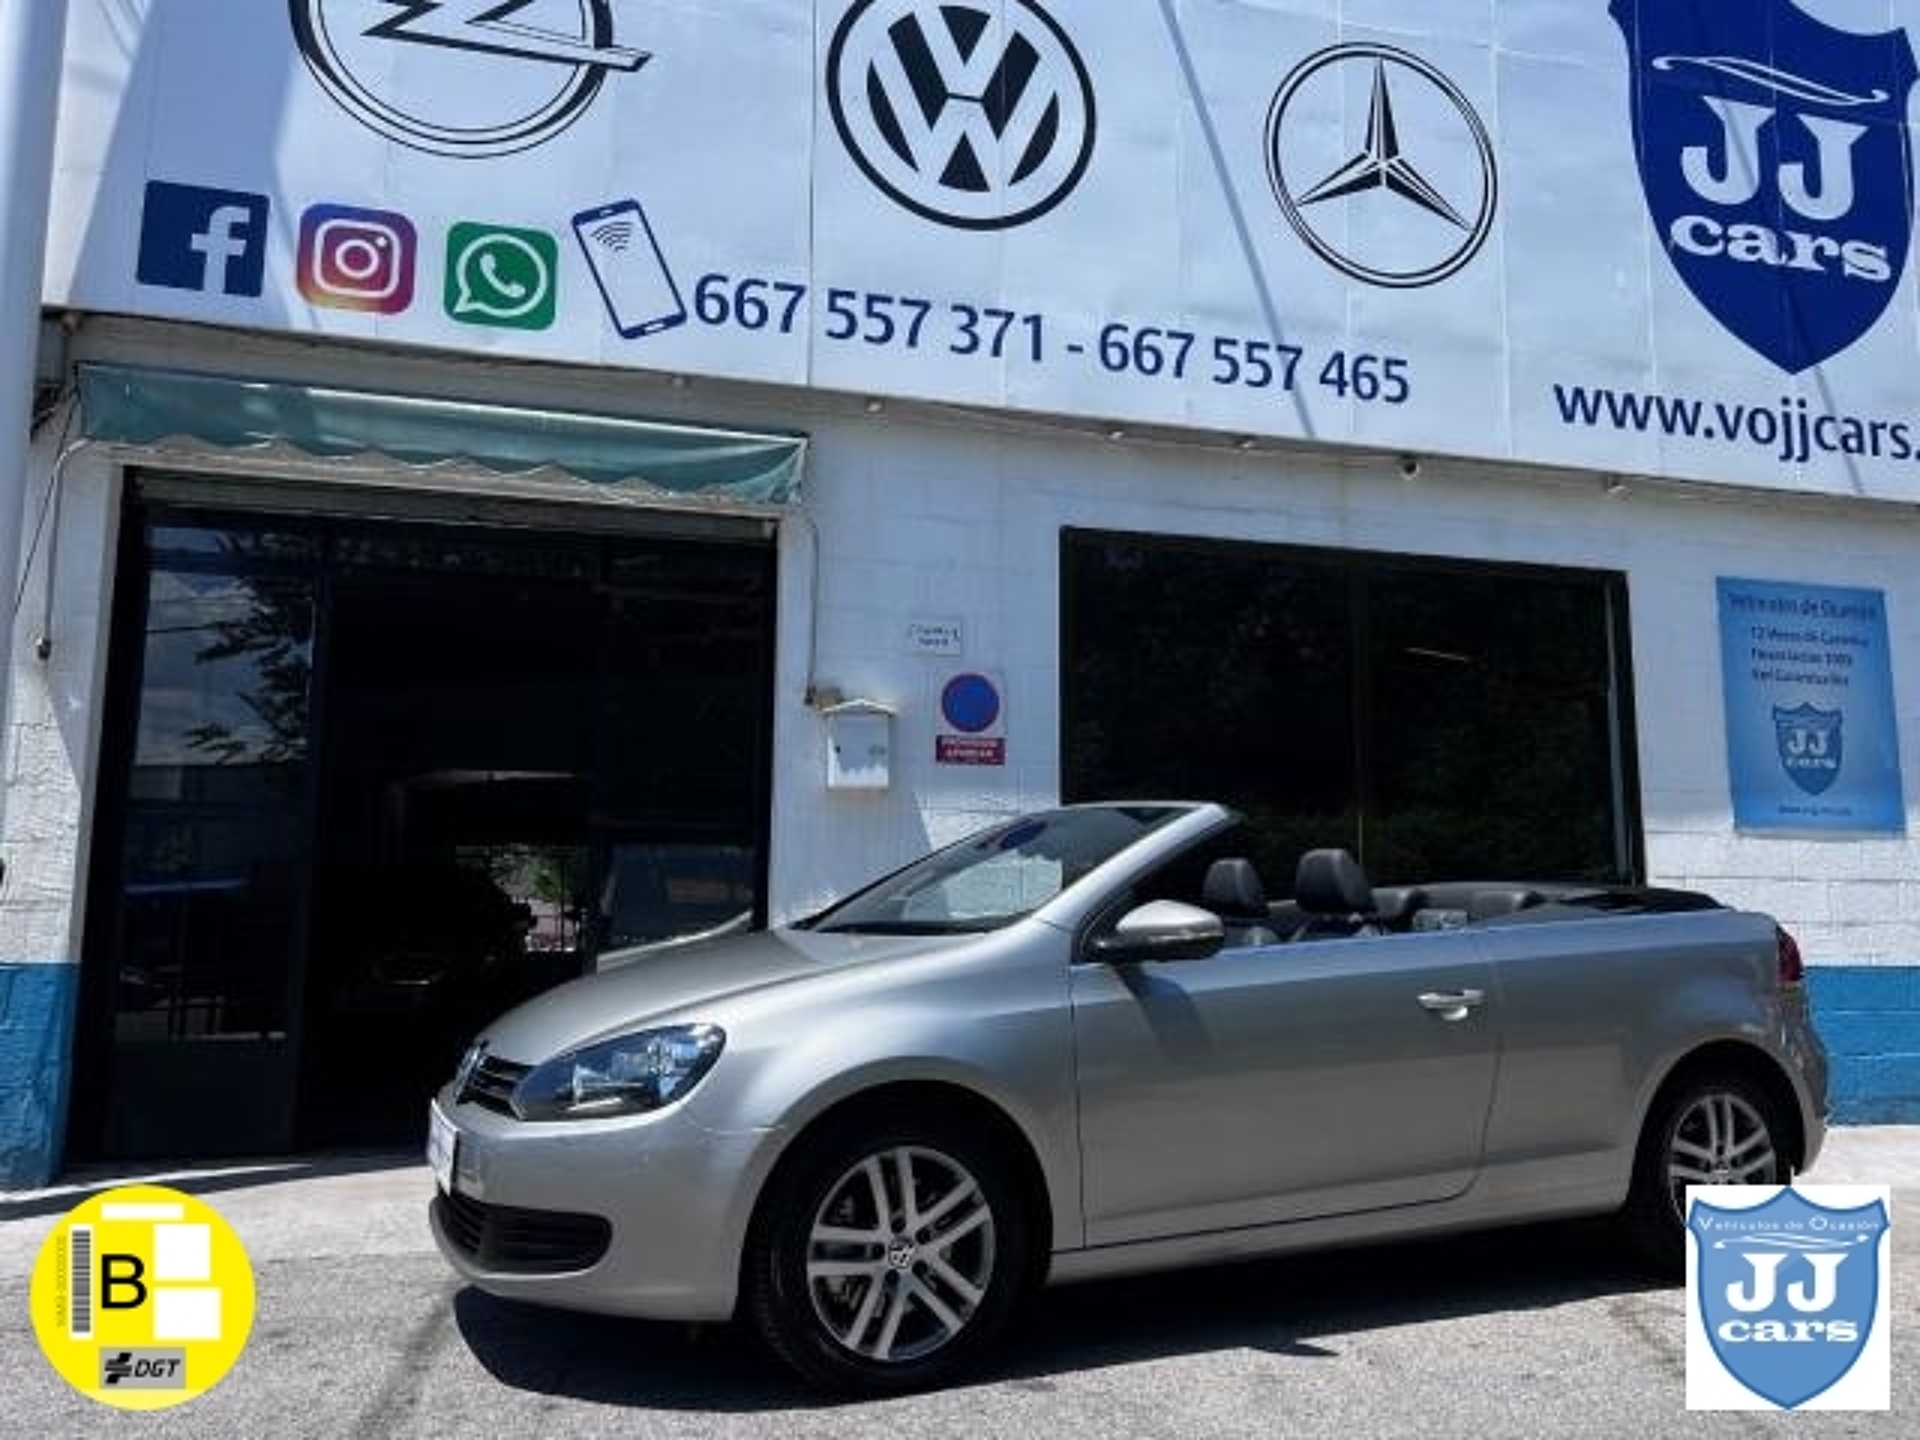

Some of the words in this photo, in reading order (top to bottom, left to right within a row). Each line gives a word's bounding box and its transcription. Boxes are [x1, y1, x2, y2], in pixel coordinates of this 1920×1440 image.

[1679, 95, 1870, 221] JJ
[1669, 214, 1892, 282] cars
[693, 273, 806, 334] 667
[824, 288, 931, 349] 557
[948, 302, 1045, 363] 371
[1099, 322, 1196, 380] 667
[1211, 335, 1303, 392] 557
[1318, 349, 1410, 404] 465
[1552, 383, 1920, 463] www.vojjcars.
[1786, 728, 1829, 757] JJ
